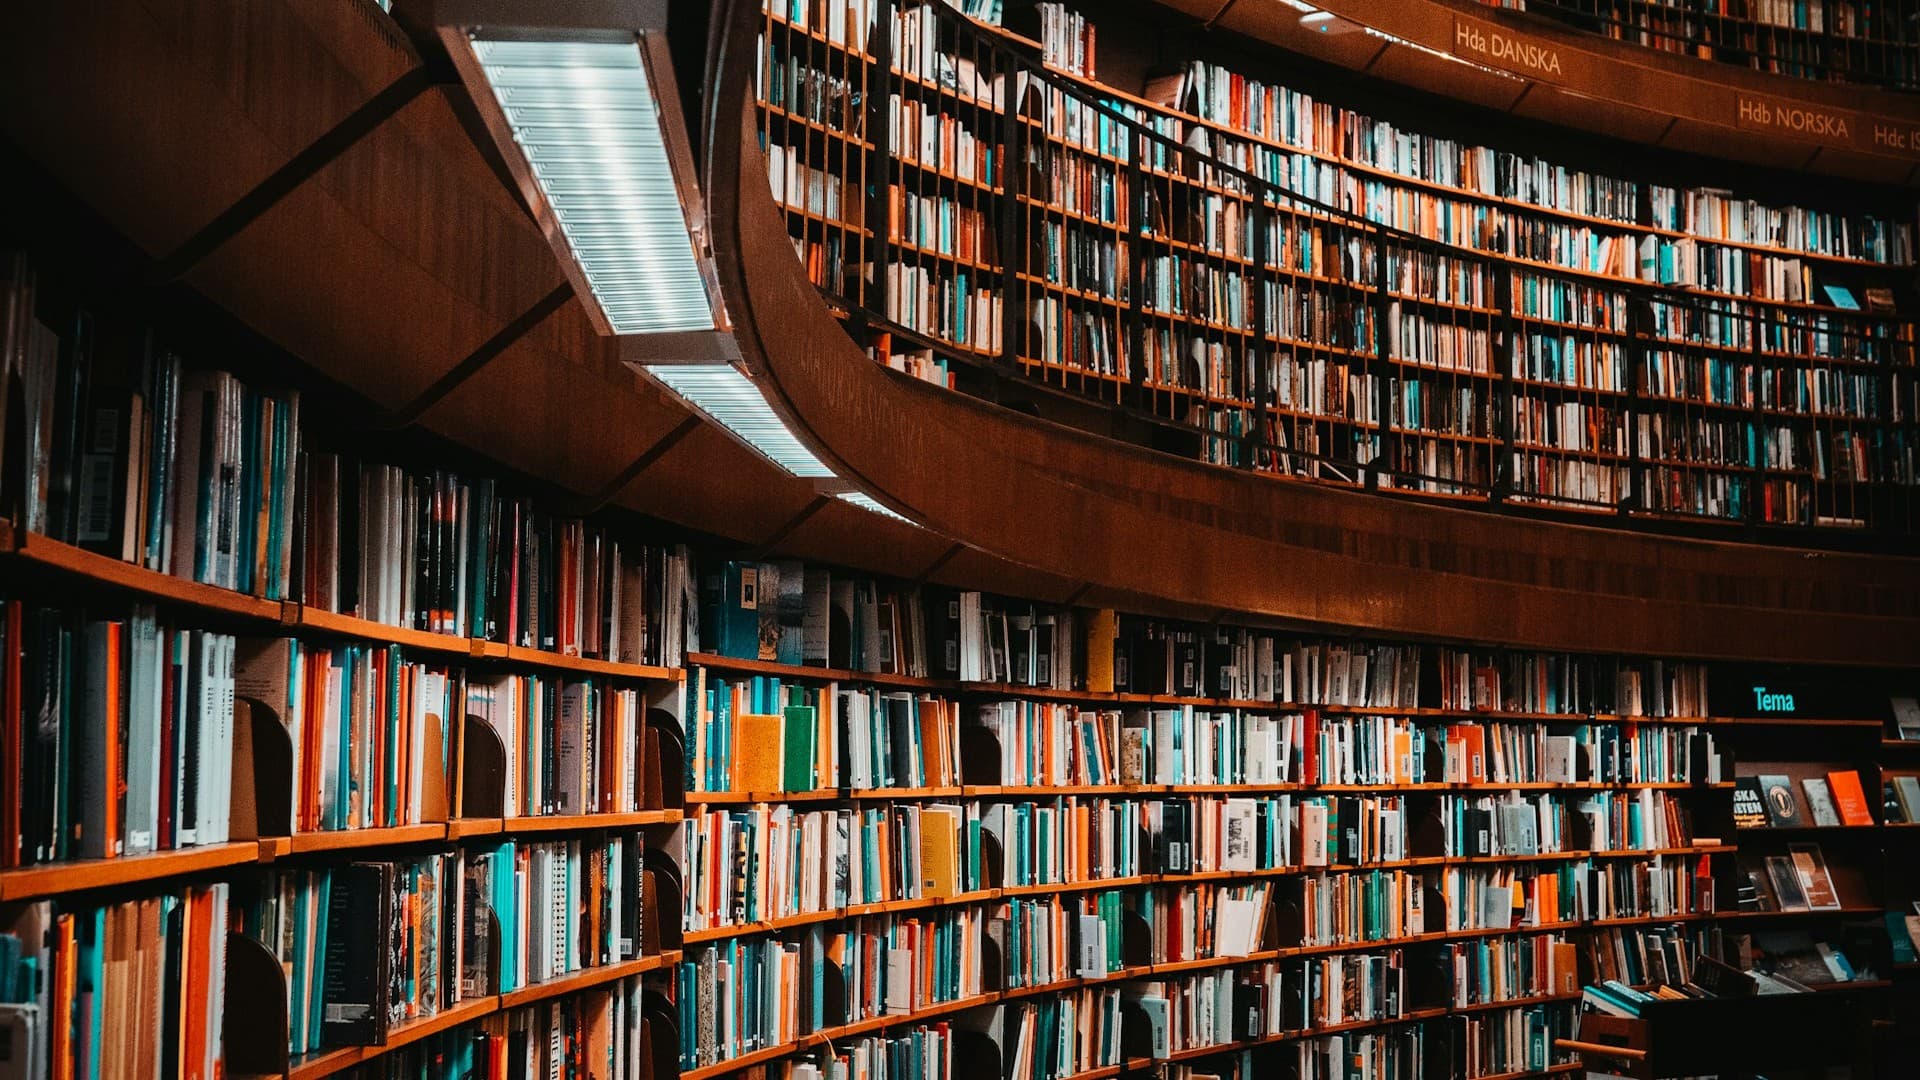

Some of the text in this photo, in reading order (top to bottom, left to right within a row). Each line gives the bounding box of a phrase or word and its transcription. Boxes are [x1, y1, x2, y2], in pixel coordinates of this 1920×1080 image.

[1457, 22, 1561, 75] Hda DANSKA
[1740, 99, 1849, 138] Hdb NORSKA
[1874, 124, 1905, 149] Hdc
[1753, 686, 1796, 712] Tema
[1733, 789, 1759, 802] SKA
